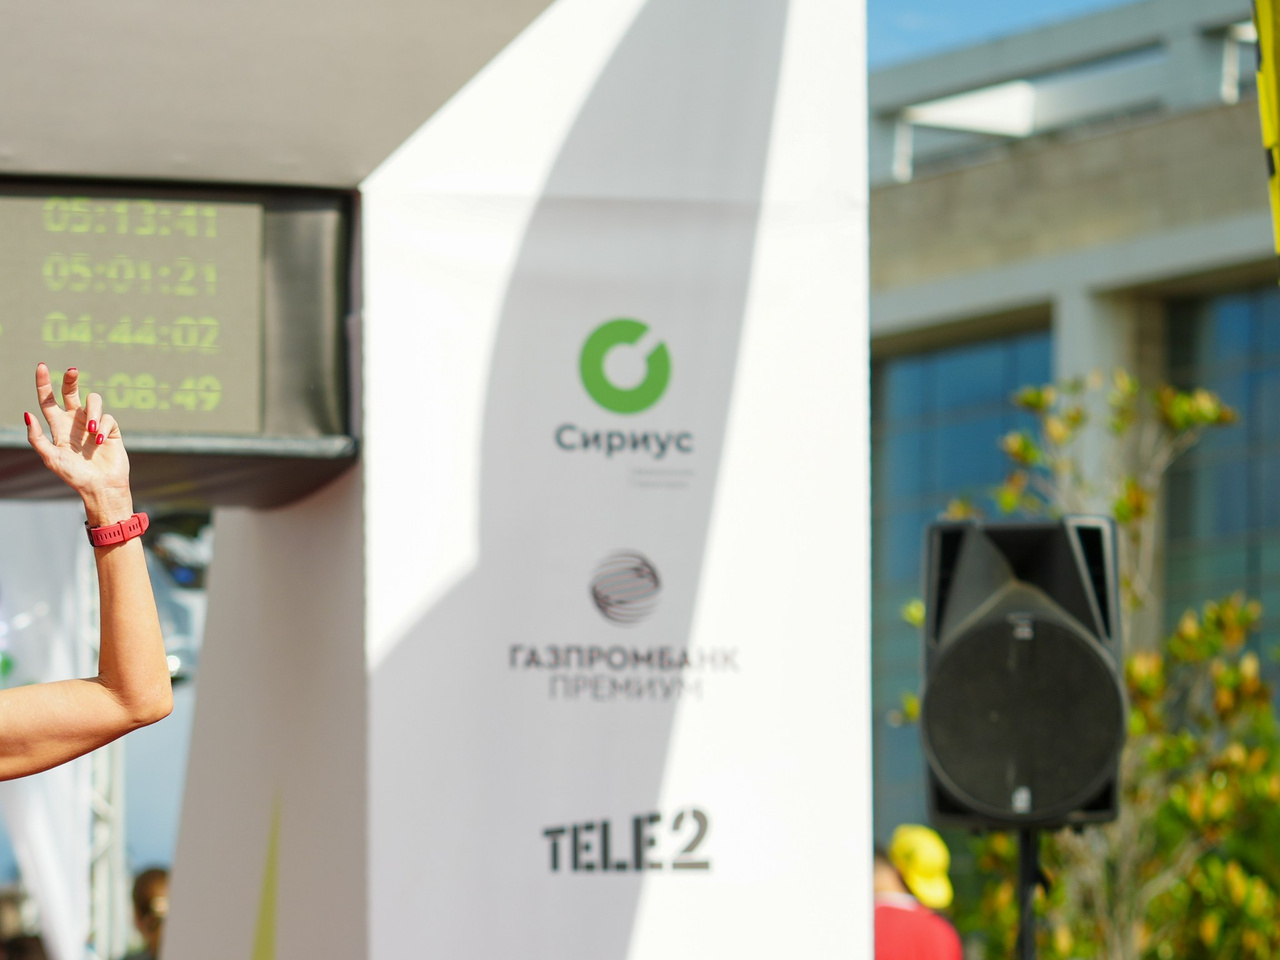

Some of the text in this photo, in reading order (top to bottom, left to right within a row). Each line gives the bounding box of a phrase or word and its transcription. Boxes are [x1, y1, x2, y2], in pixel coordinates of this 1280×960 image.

[42, 196, 218, 238] 05:13:41
[42, 252, 218, 297] 05:01:21
[42, 310, 220, 352] 04:44:02
[554, 423, 695, 459] Сириус
[509, 643, 740, 672] ГАЗПРОМБАНК
[548, 675, 704, 702] ПРЕМИУМ
[542, 807, 711, 872] TELE2
